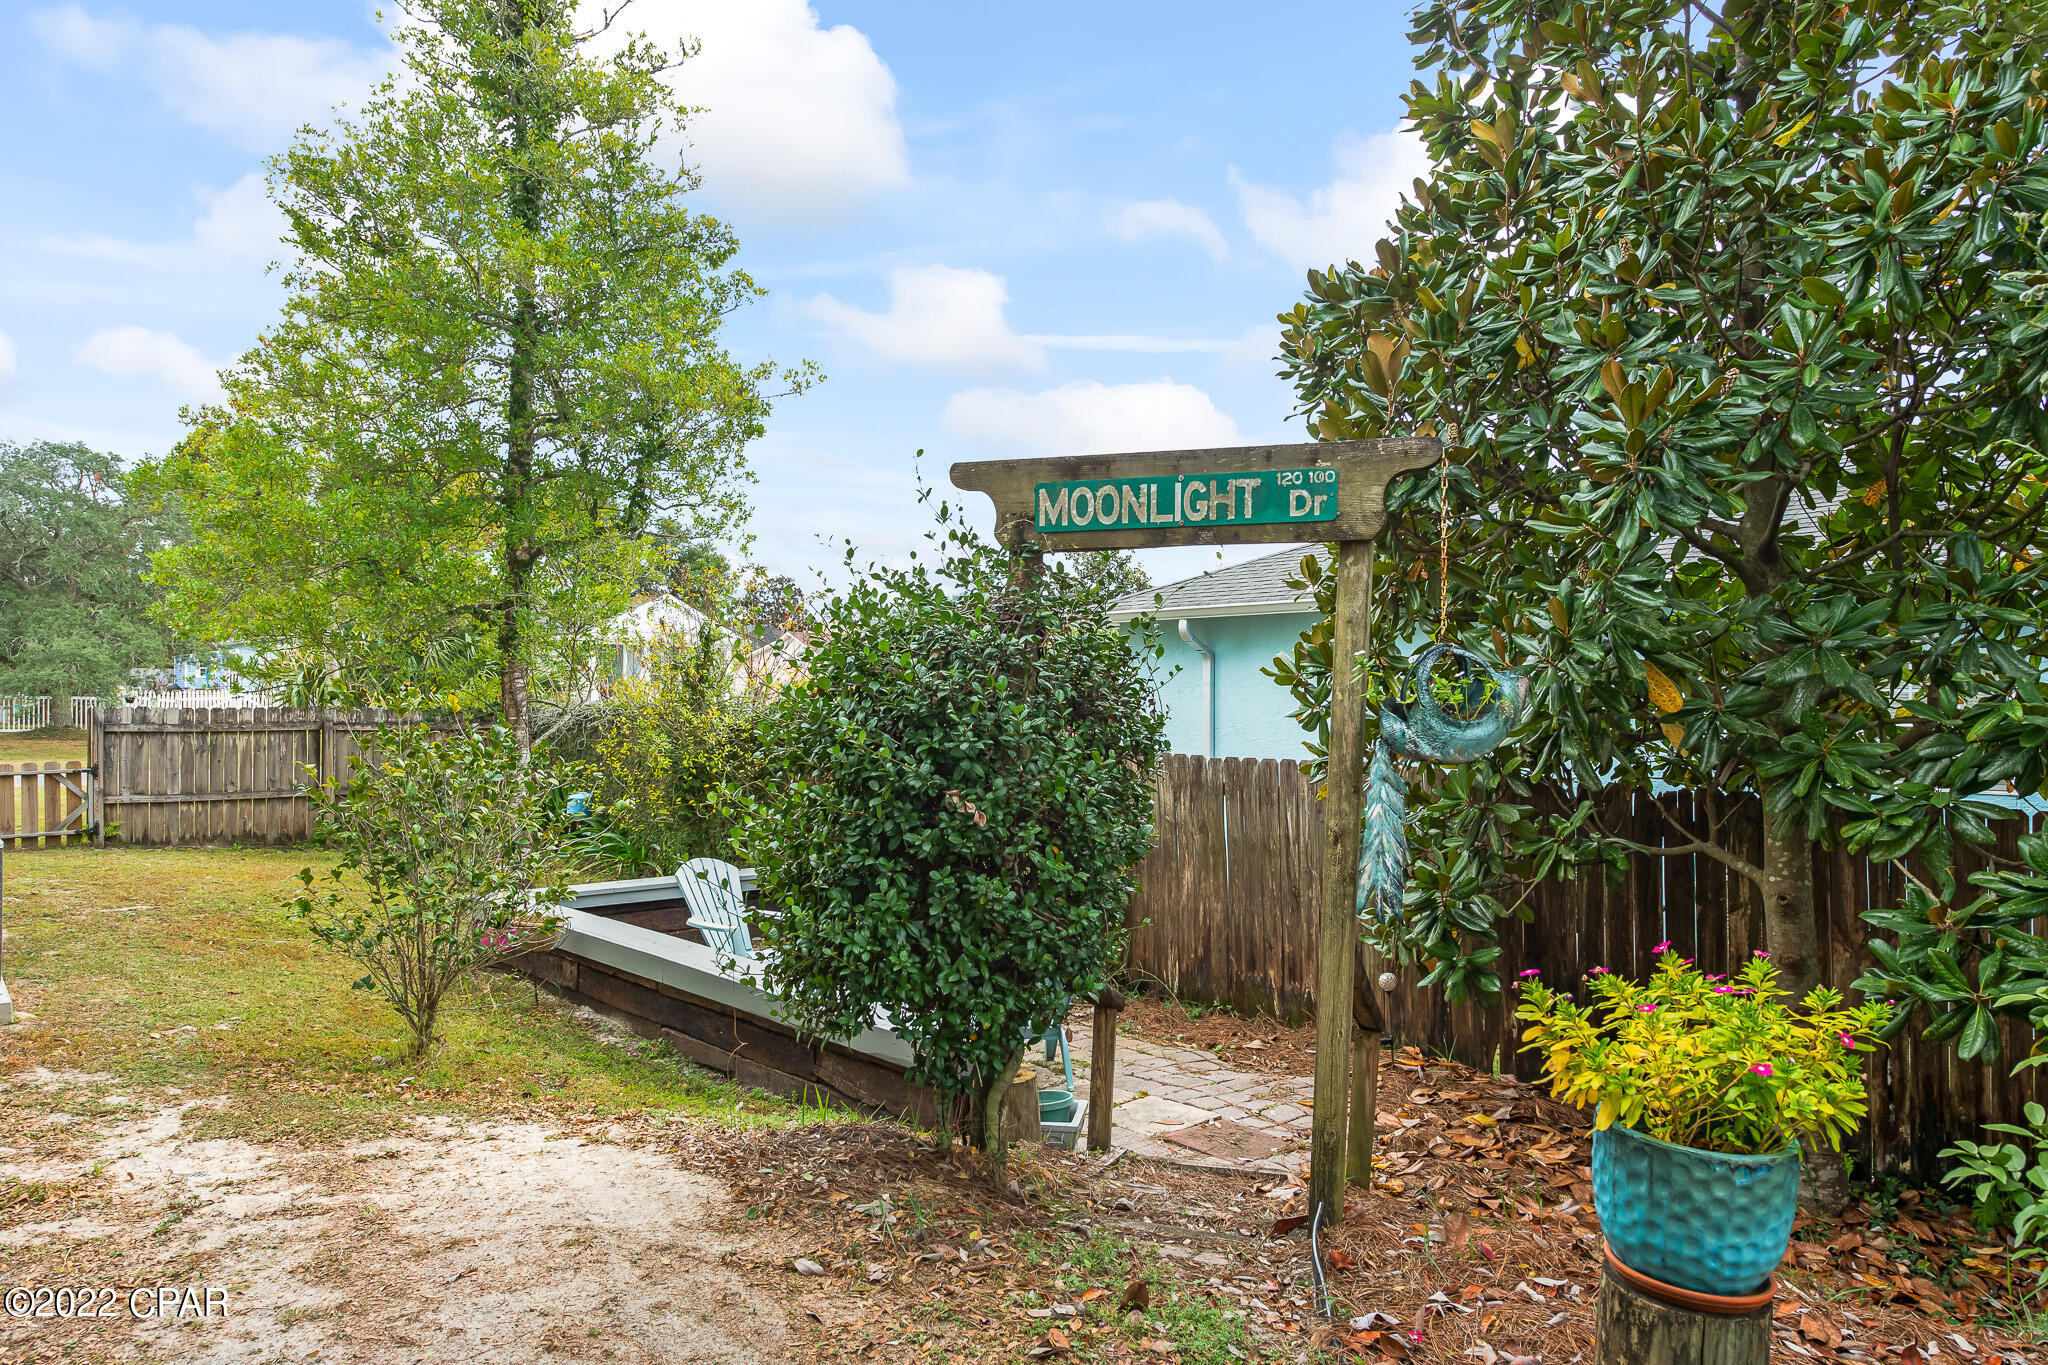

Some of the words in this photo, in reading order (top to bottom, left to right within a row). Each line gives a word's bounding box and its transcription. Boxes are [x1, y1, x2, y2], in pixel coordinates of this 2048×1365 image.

[1276, 471, 1303, 486] 120
[1308, 470, 1336, 484] 100
[1038, 478, 1261, 526] MOONLIGHT
[1289, 489, 1328, 517] Dr
